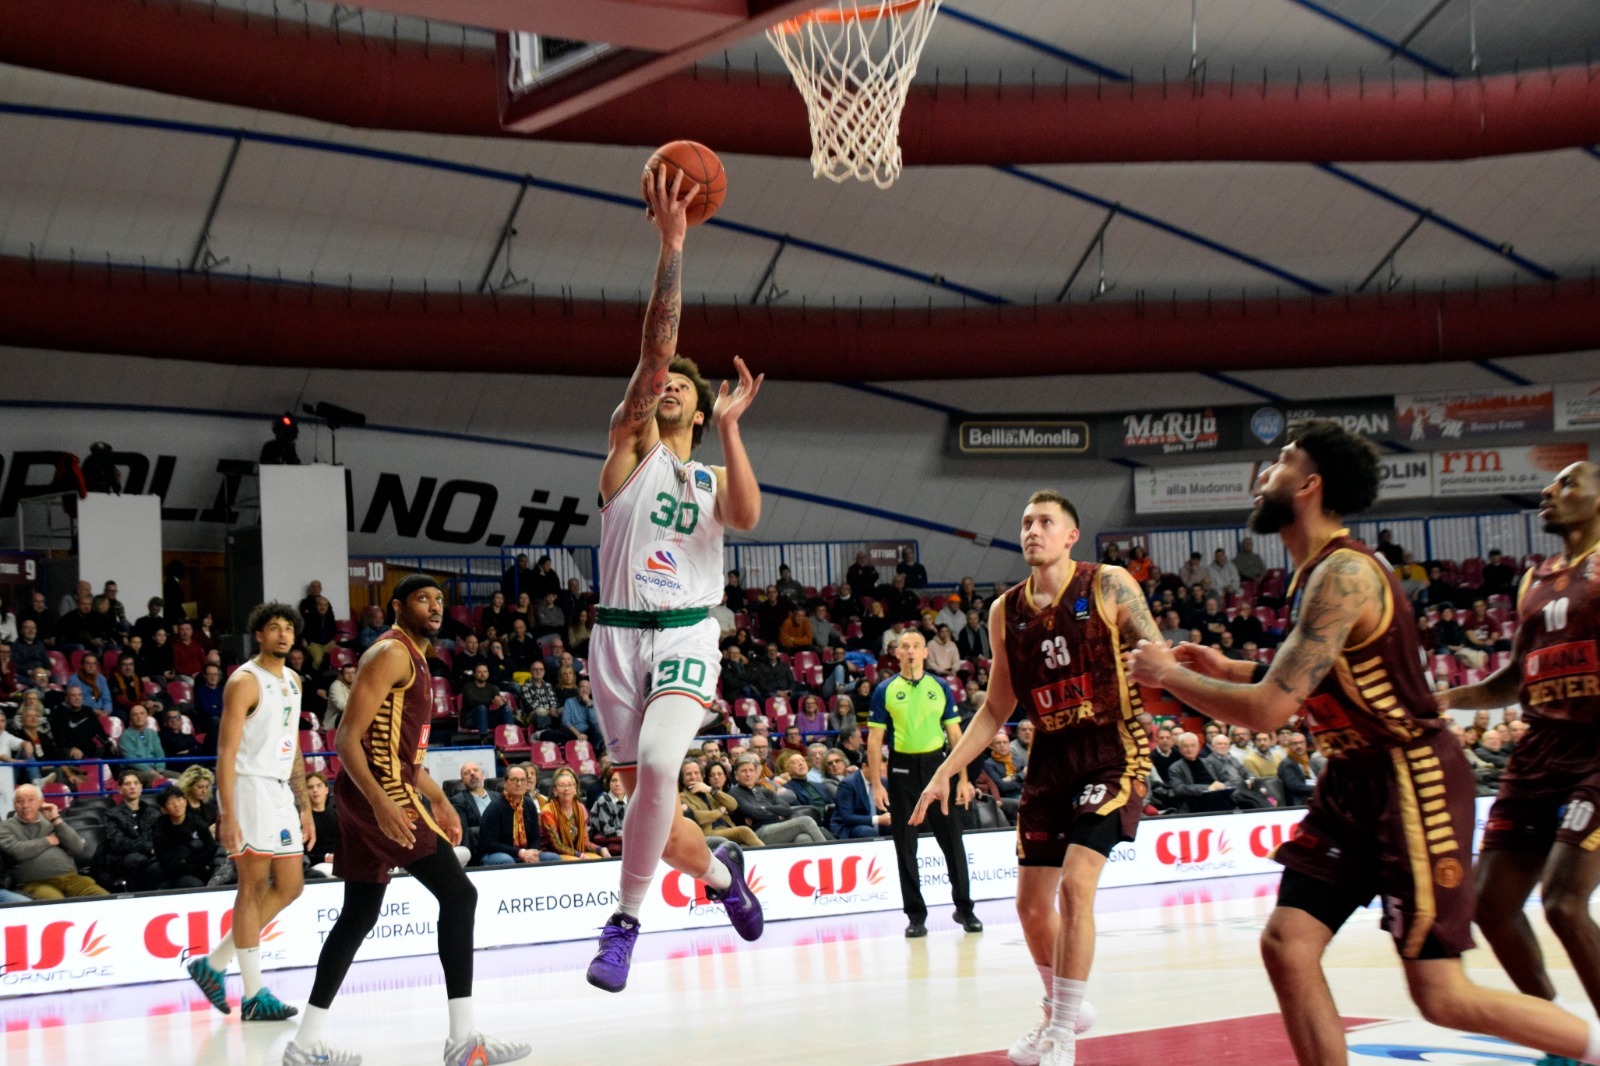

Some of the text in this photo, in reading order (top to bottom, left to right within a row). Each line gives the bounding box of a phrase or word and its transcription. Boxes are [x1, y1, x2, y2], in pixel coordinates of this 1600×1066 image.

[1440, 449, 1504, 474] rm
[1166, 481, 1243, 496] alla Madonna
[650, 491, 699, 535] 30
[25, 559, 37, 581] 9
[368, 561, 384, 582] 10
[635, 573, 683, 591] aquapark
[1542, 597, 1570, 632] 10
[1041, 635, 1071, 669] 33
[657, 657, 706, 687] 30
[284, 706, 292, 726] 7
[1561, 799, 1595, 832] 10
[1155, 828, 1213, 865] CIS
[788, 855, 863, 897] CIS
[4, 920, 75, 973] IS
